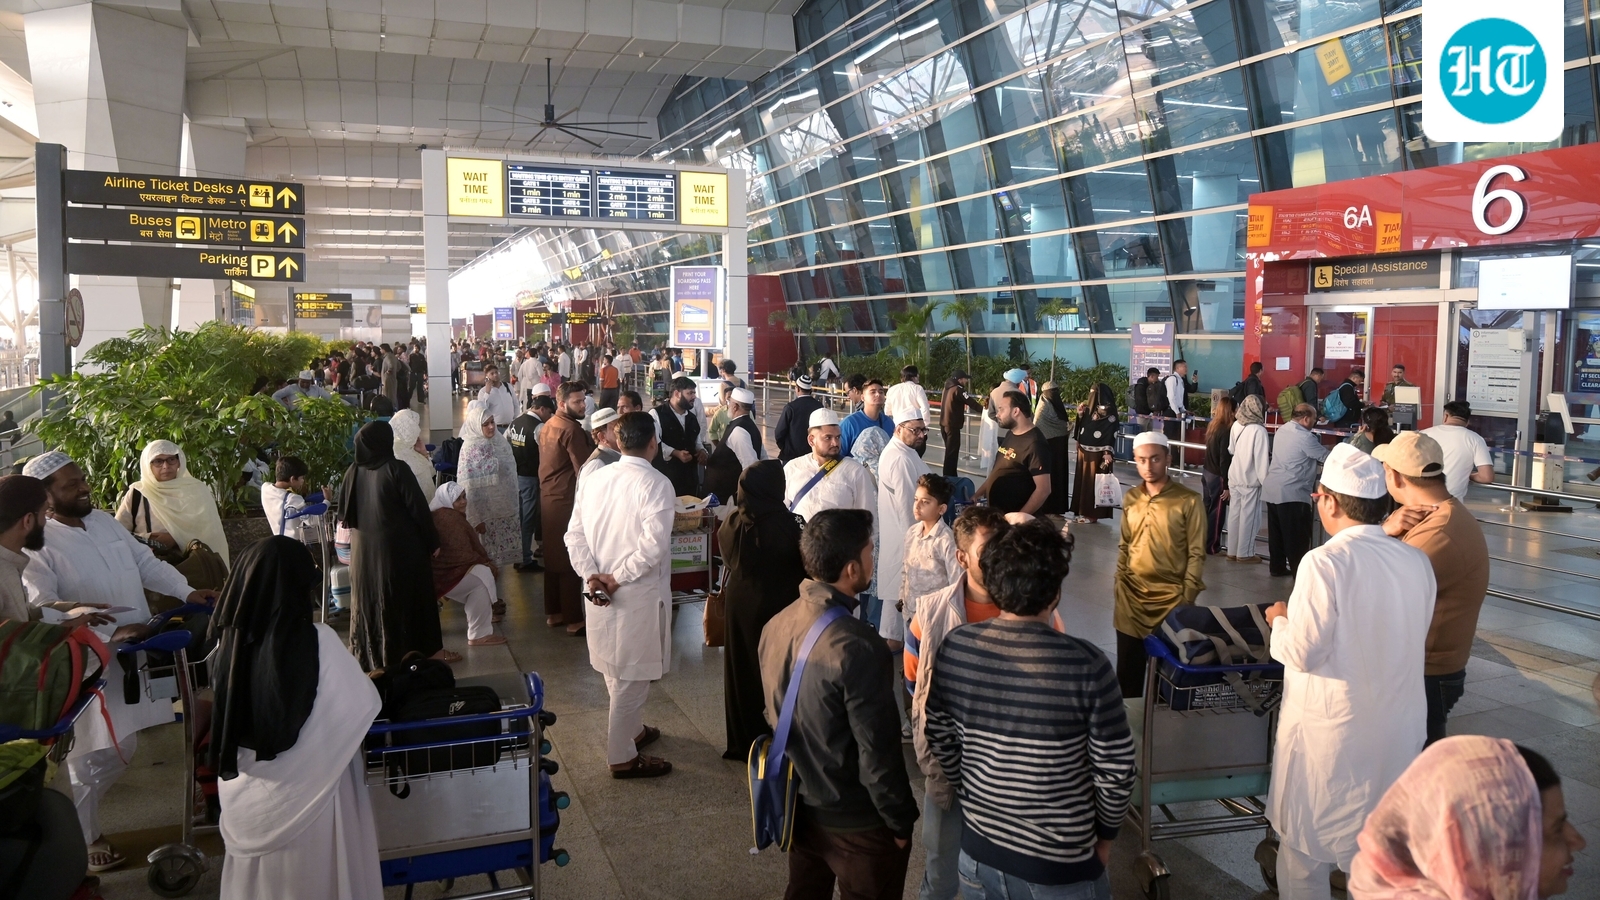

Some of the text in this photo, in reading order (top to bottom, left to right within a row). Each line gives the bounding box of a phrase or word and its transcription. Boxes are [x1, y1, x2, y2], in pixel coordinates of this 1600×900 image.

[463, 172, 488, 182] WAIT
[104, 176, 246, 195] Airline Ticket Desks A
[463, 184, 488, 194] TIME
[694, 185, 715, 193] WAIT
[140, 193, 177, 203] एयरलाइन
[181, 194, 204, 204] टिकट
[207, 195, 226, 205] डेस्क
[694, 196, 715, 205] TIME
[1472, 164, 1526, 235] 6
[130, 214, 172, 227] Buses
[1343, 204, 1373, 229] 6A
[209, 218, 247, 229] Metro
[140, 228, 173, 239] बस सेवा
[200, 252, 248, 267] Parking
[224, 267, 248, 277] पार्किंग
[1334, 260, 1427, 276] Special Assistance
[1334, 278, 1374, 287] विशेष सहायता
[694, 333, 704, 341] T3
